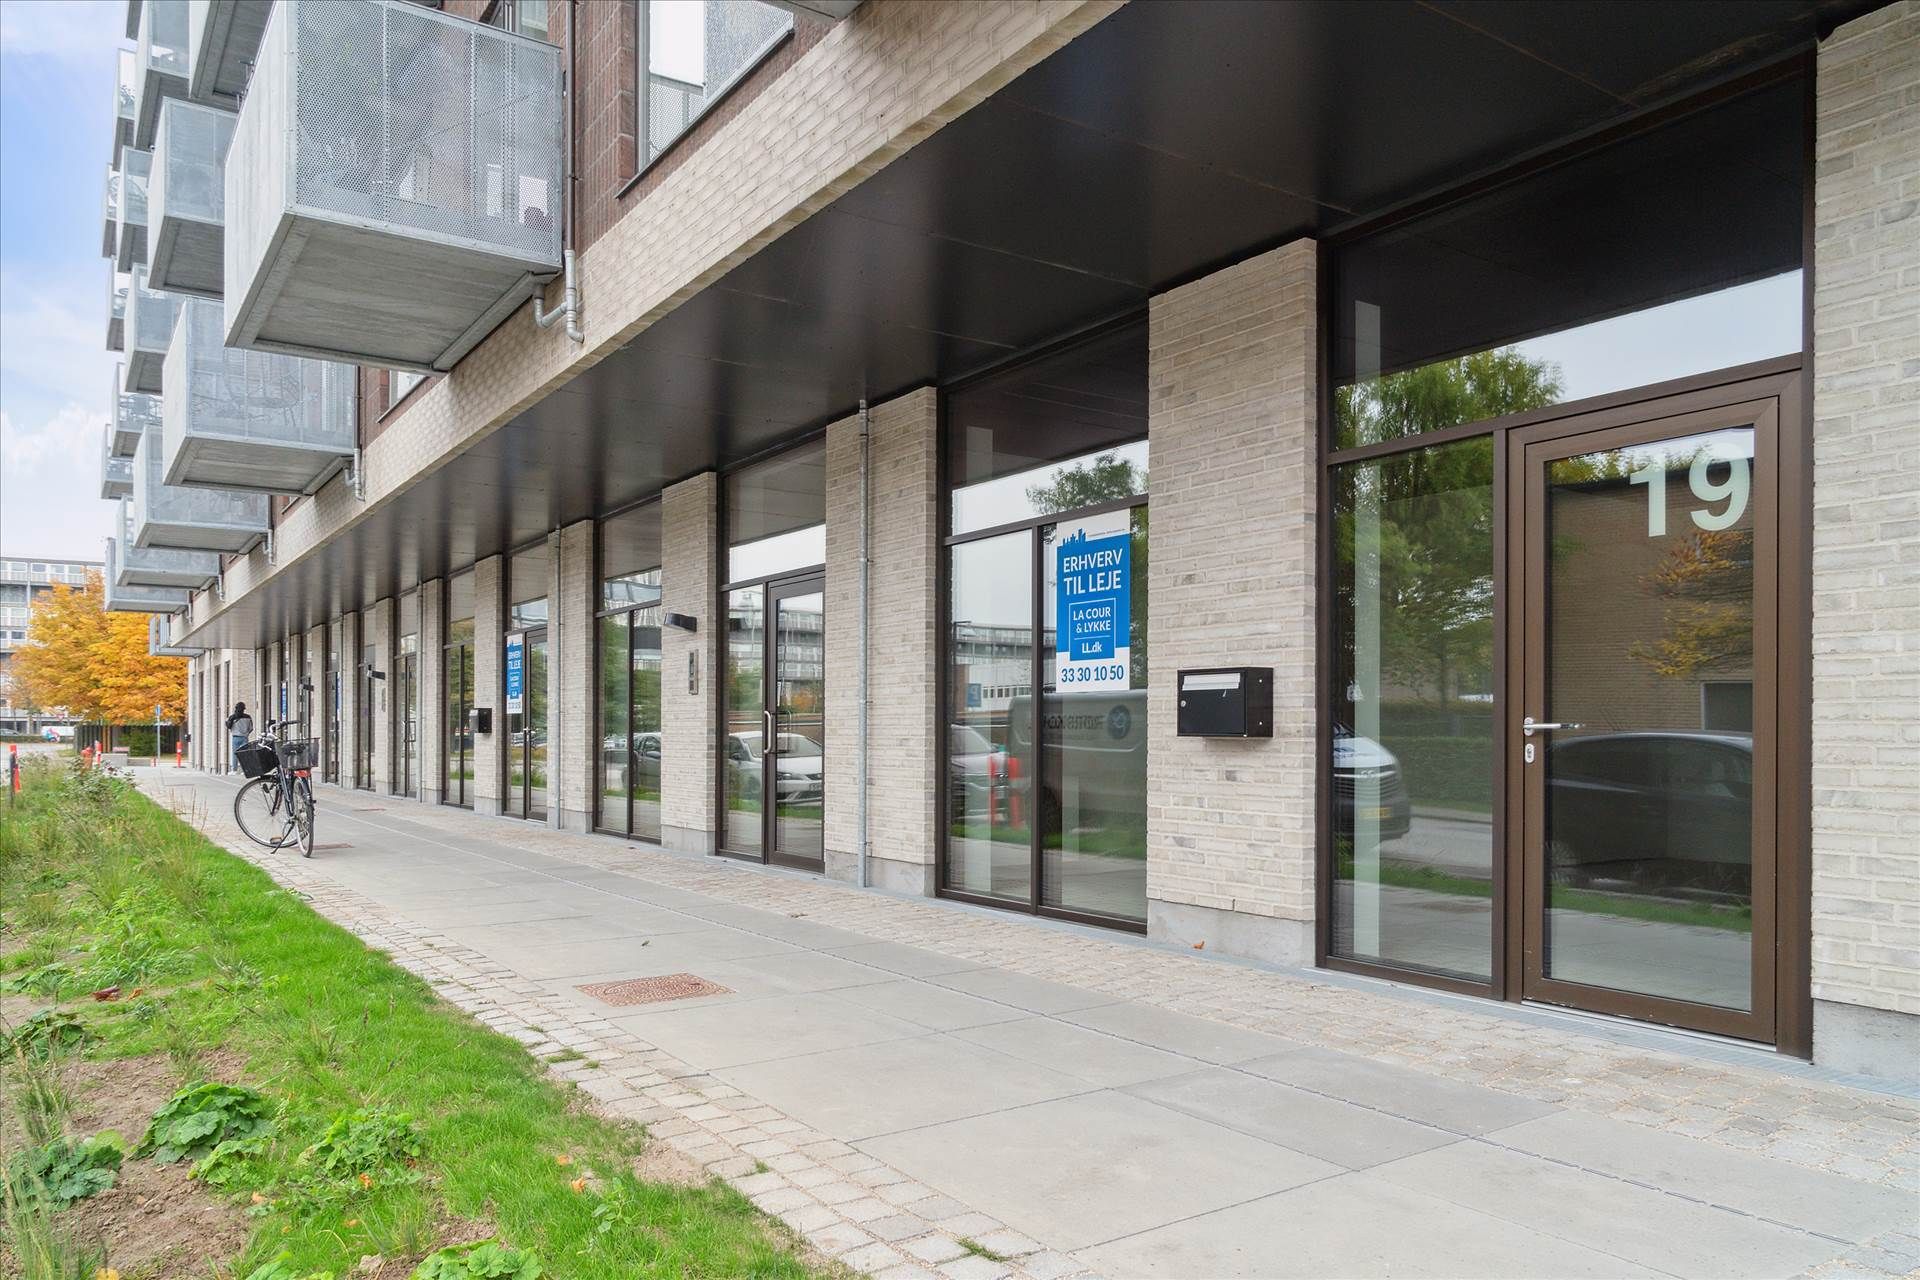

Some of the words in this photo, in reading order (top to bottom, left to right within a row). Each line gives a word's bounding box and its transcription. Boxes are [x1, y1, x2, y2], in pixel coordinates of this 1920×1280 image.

[1629, 442, 1750, 537] 19
[1063, 548, 1123, 573] ERHVERV
[1063, 576, 1086, 596] TIL
[1089, 570, 1122, 593] LEJE
[1073, 610, 1084, 621] LA
[1085, 606, 1111, 620] COUR
[1076, 623, 1082, 634] &
[1084, 619, 1111, 633] LYKKE
[1082, 641, 1102, 654] LL.dk
[1061, 668, 1075, 683] 33
[1077, 667, 1091, 682] 30
[1094, 665, 1108, 681] 10
[1109, 664, 1124, 681] 50
